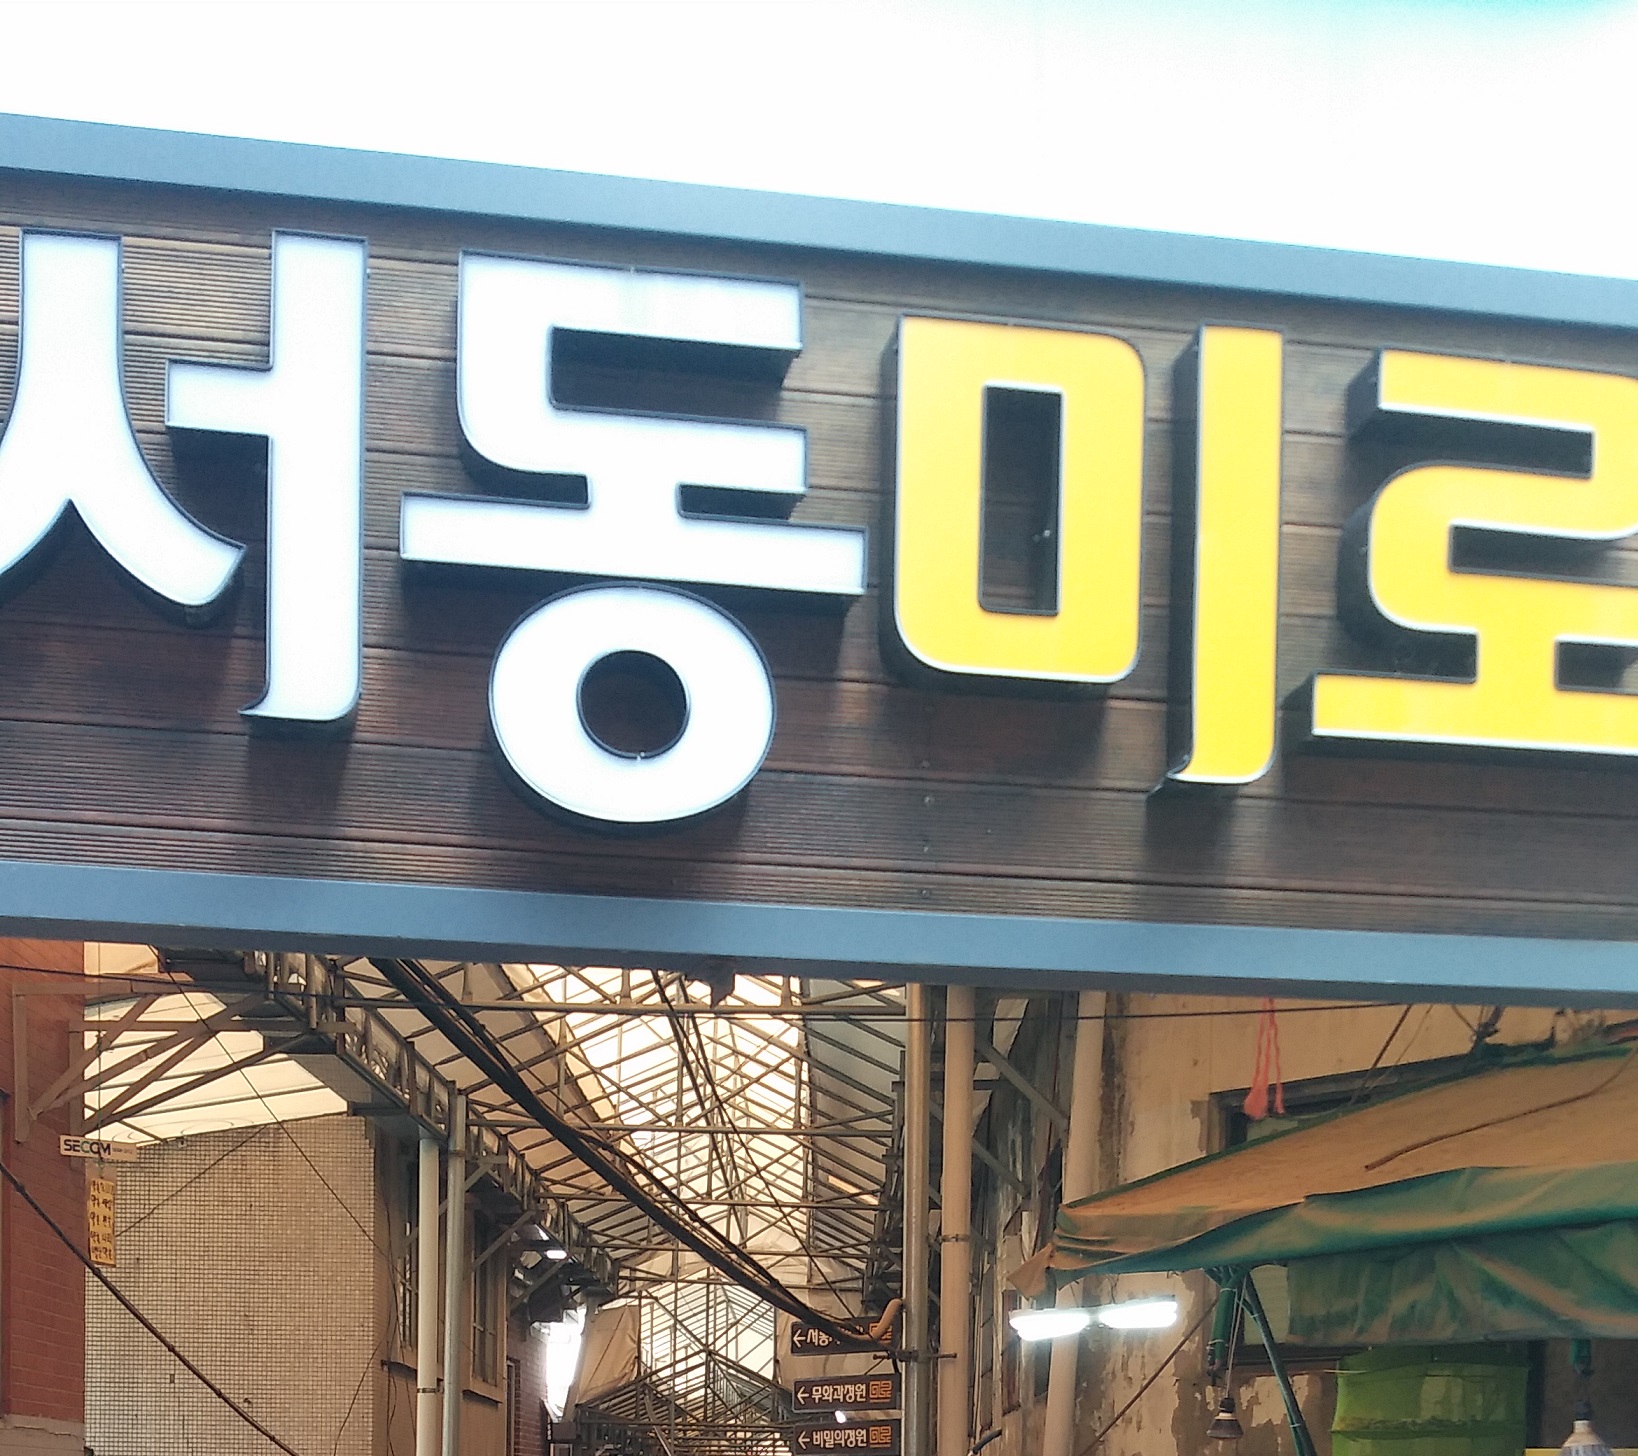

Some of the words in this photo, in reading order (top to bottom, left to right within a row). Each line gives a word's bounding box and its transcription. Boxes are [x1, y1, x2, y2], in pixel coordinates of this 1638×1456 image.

[63, 1139, 111, 1155] SECOM
[812, 1383, 866, 1403] 무화과정원
[813, 1429, 866, 1448] 비밀의정원
